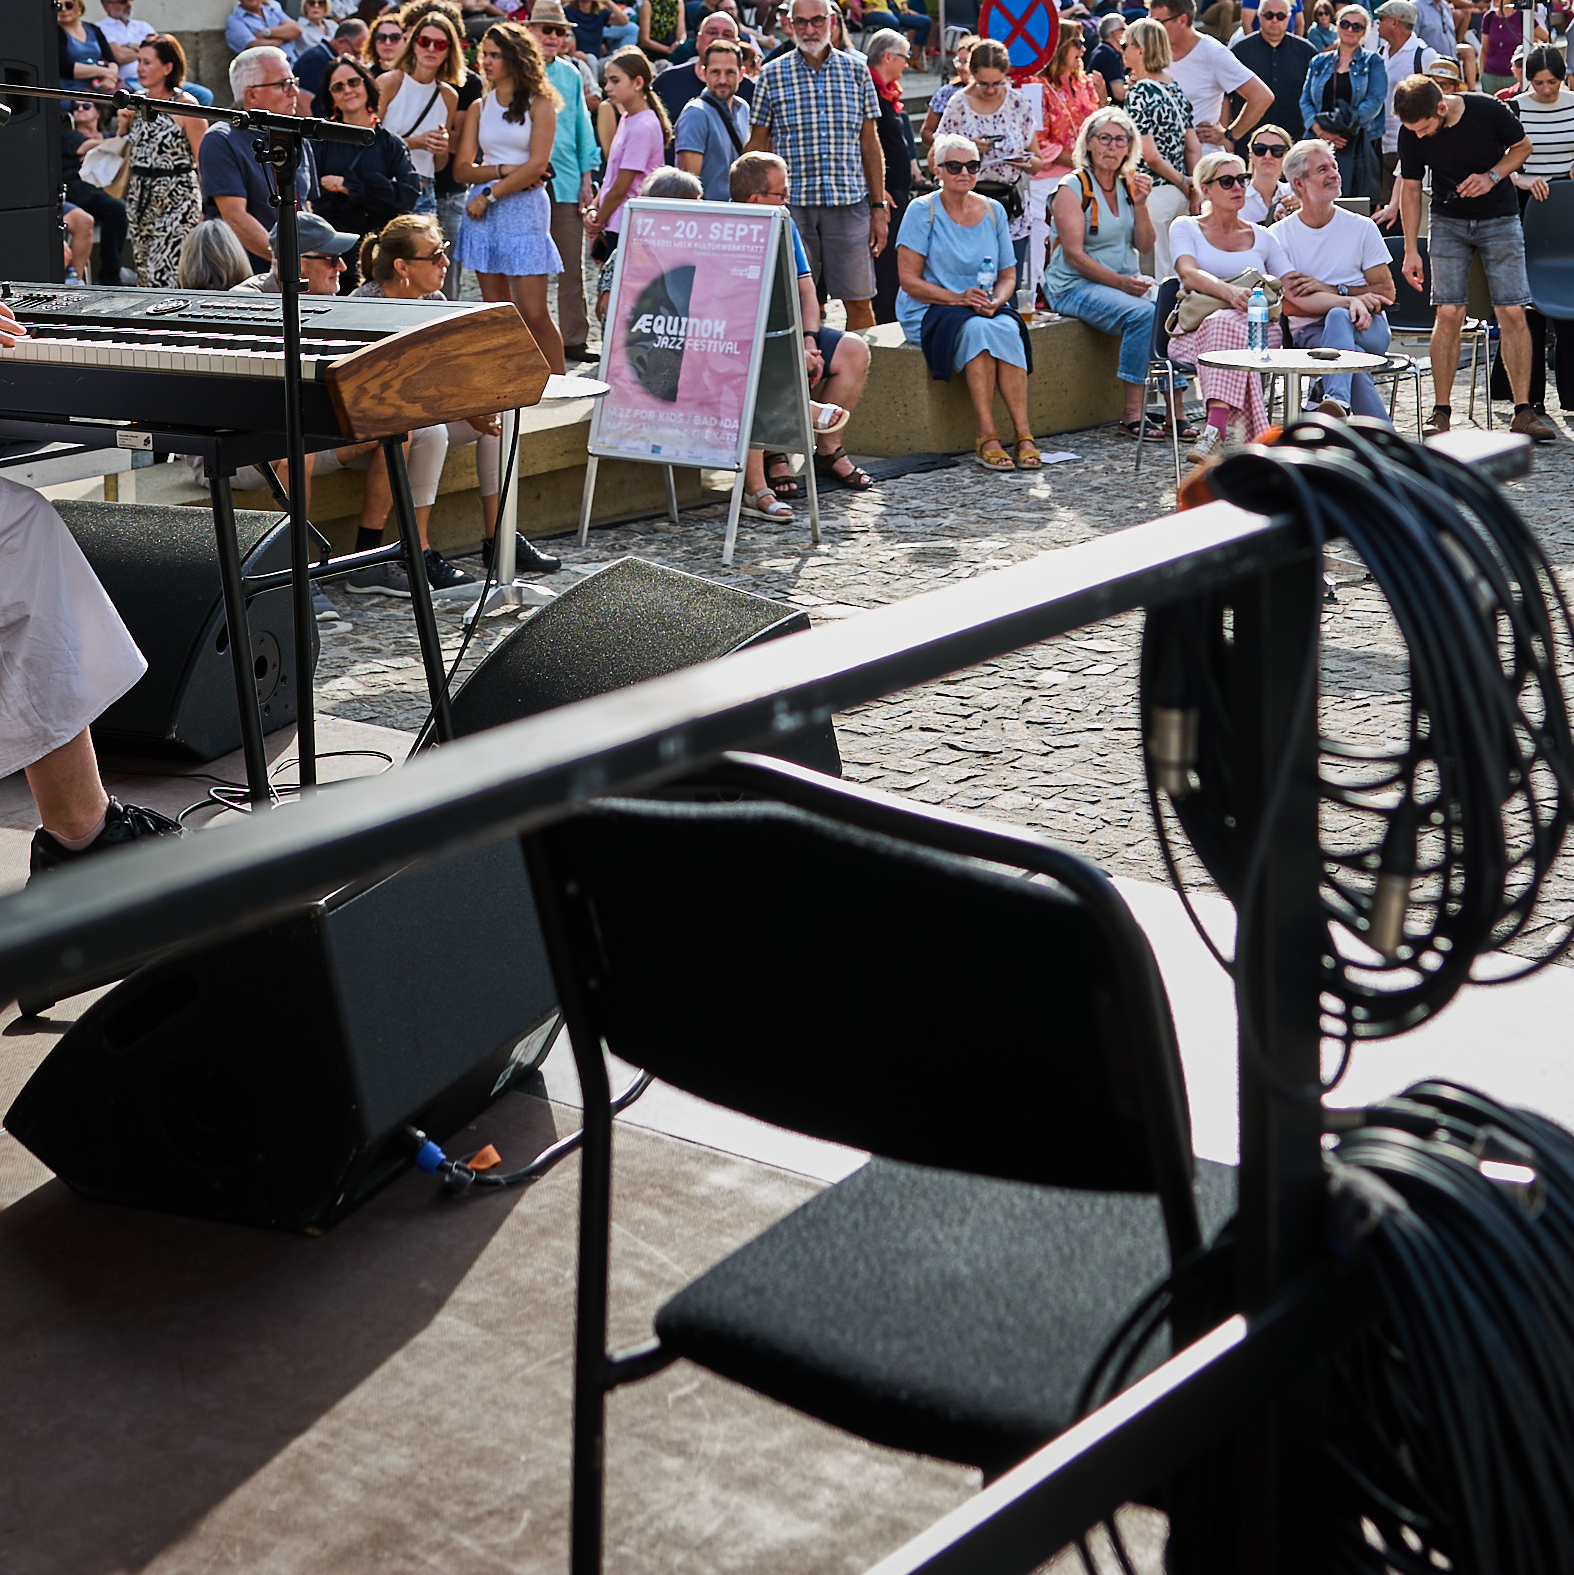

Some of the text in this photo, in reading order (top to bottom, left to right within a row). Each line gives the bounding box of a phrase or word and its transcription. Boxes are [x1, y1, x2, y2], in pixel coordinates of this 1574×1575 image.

[635, 218, 655, 236] 17.
[674, 220, 702, 239] 20.
[709, 222, 765, 243] SEPT.
[653, 335, 741, 355] JAZZ FESTIVAL
[633, 409, 655, 420] FOR
[659, 411, 684, 423] KIDS
[694, 415, 717, 426] BAD
